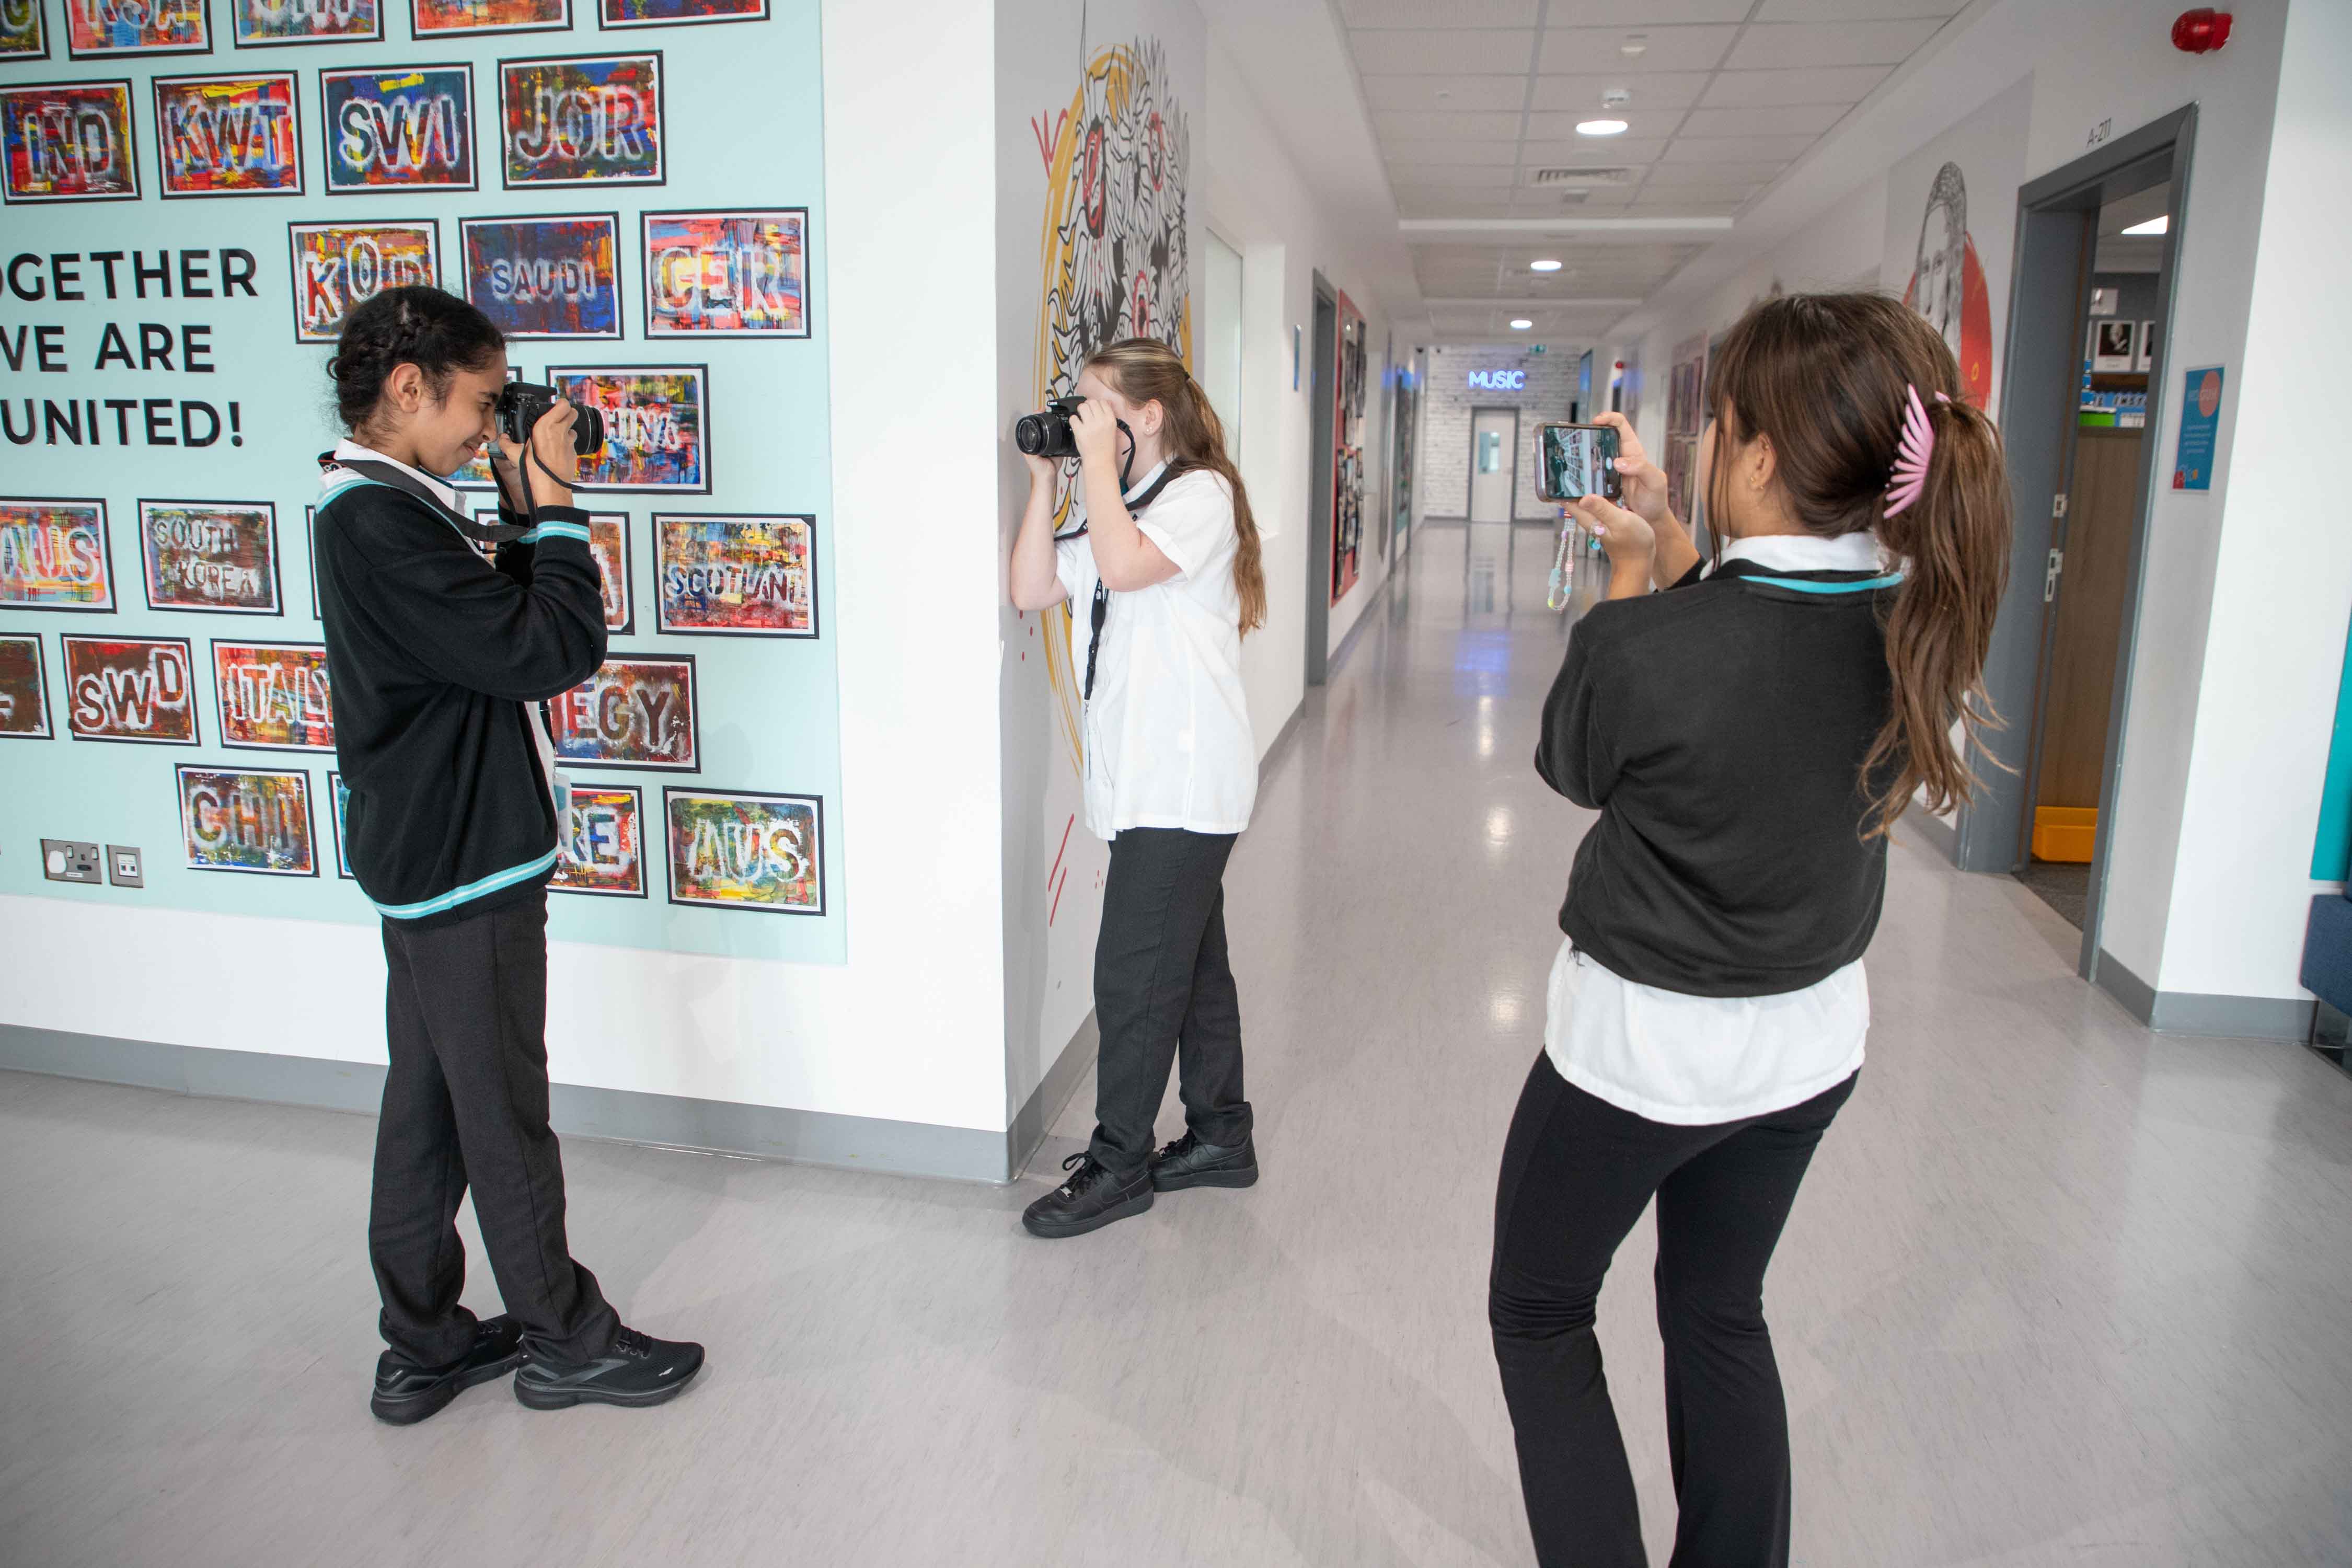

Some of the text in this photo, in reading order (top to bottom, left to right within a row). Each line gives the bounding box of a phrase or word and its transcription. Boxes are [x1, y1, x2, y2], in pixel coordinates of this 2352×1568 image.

[166, 99, 292, 172] KWT
[339, 96, 460, 170] SWI
[515, 85, 644, 160] JOR
[0, 248, 259, 301] GETHER
[492, 258, 597, 303] SAUDI
[659, 245, 786, 317] GER
[94, 322, 216, 373] ARE
[1469, 370, 1525, 389] MUSIC
[1, 398, 244, 447] UNITED!
[601, 407, 679, 451] HINA
[154, 519, 239, 554] SOUTH
[175, 558, 257, 600] KOREA
[75, 648, 188, 732] SWD
[561, 678, 672, 753] EGY
[687, 815, 808, 882] AUS
